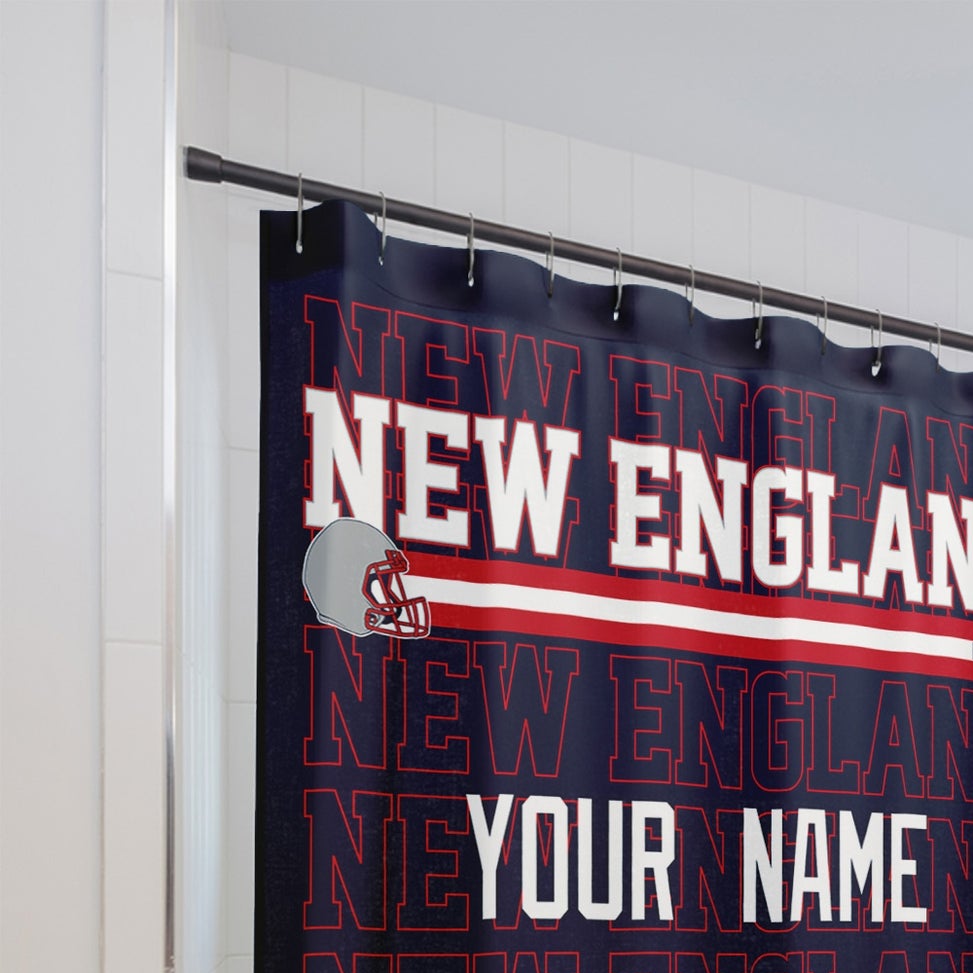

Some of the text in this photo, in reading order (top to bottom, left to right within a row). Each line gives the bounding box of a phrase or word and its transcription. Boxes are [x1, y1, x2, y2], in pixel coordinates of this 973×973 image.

[303, 386, 581, 558] NEW
[304, 624, 580, 778] NEW
[466, 793, 928, 923] YOUR NAME
